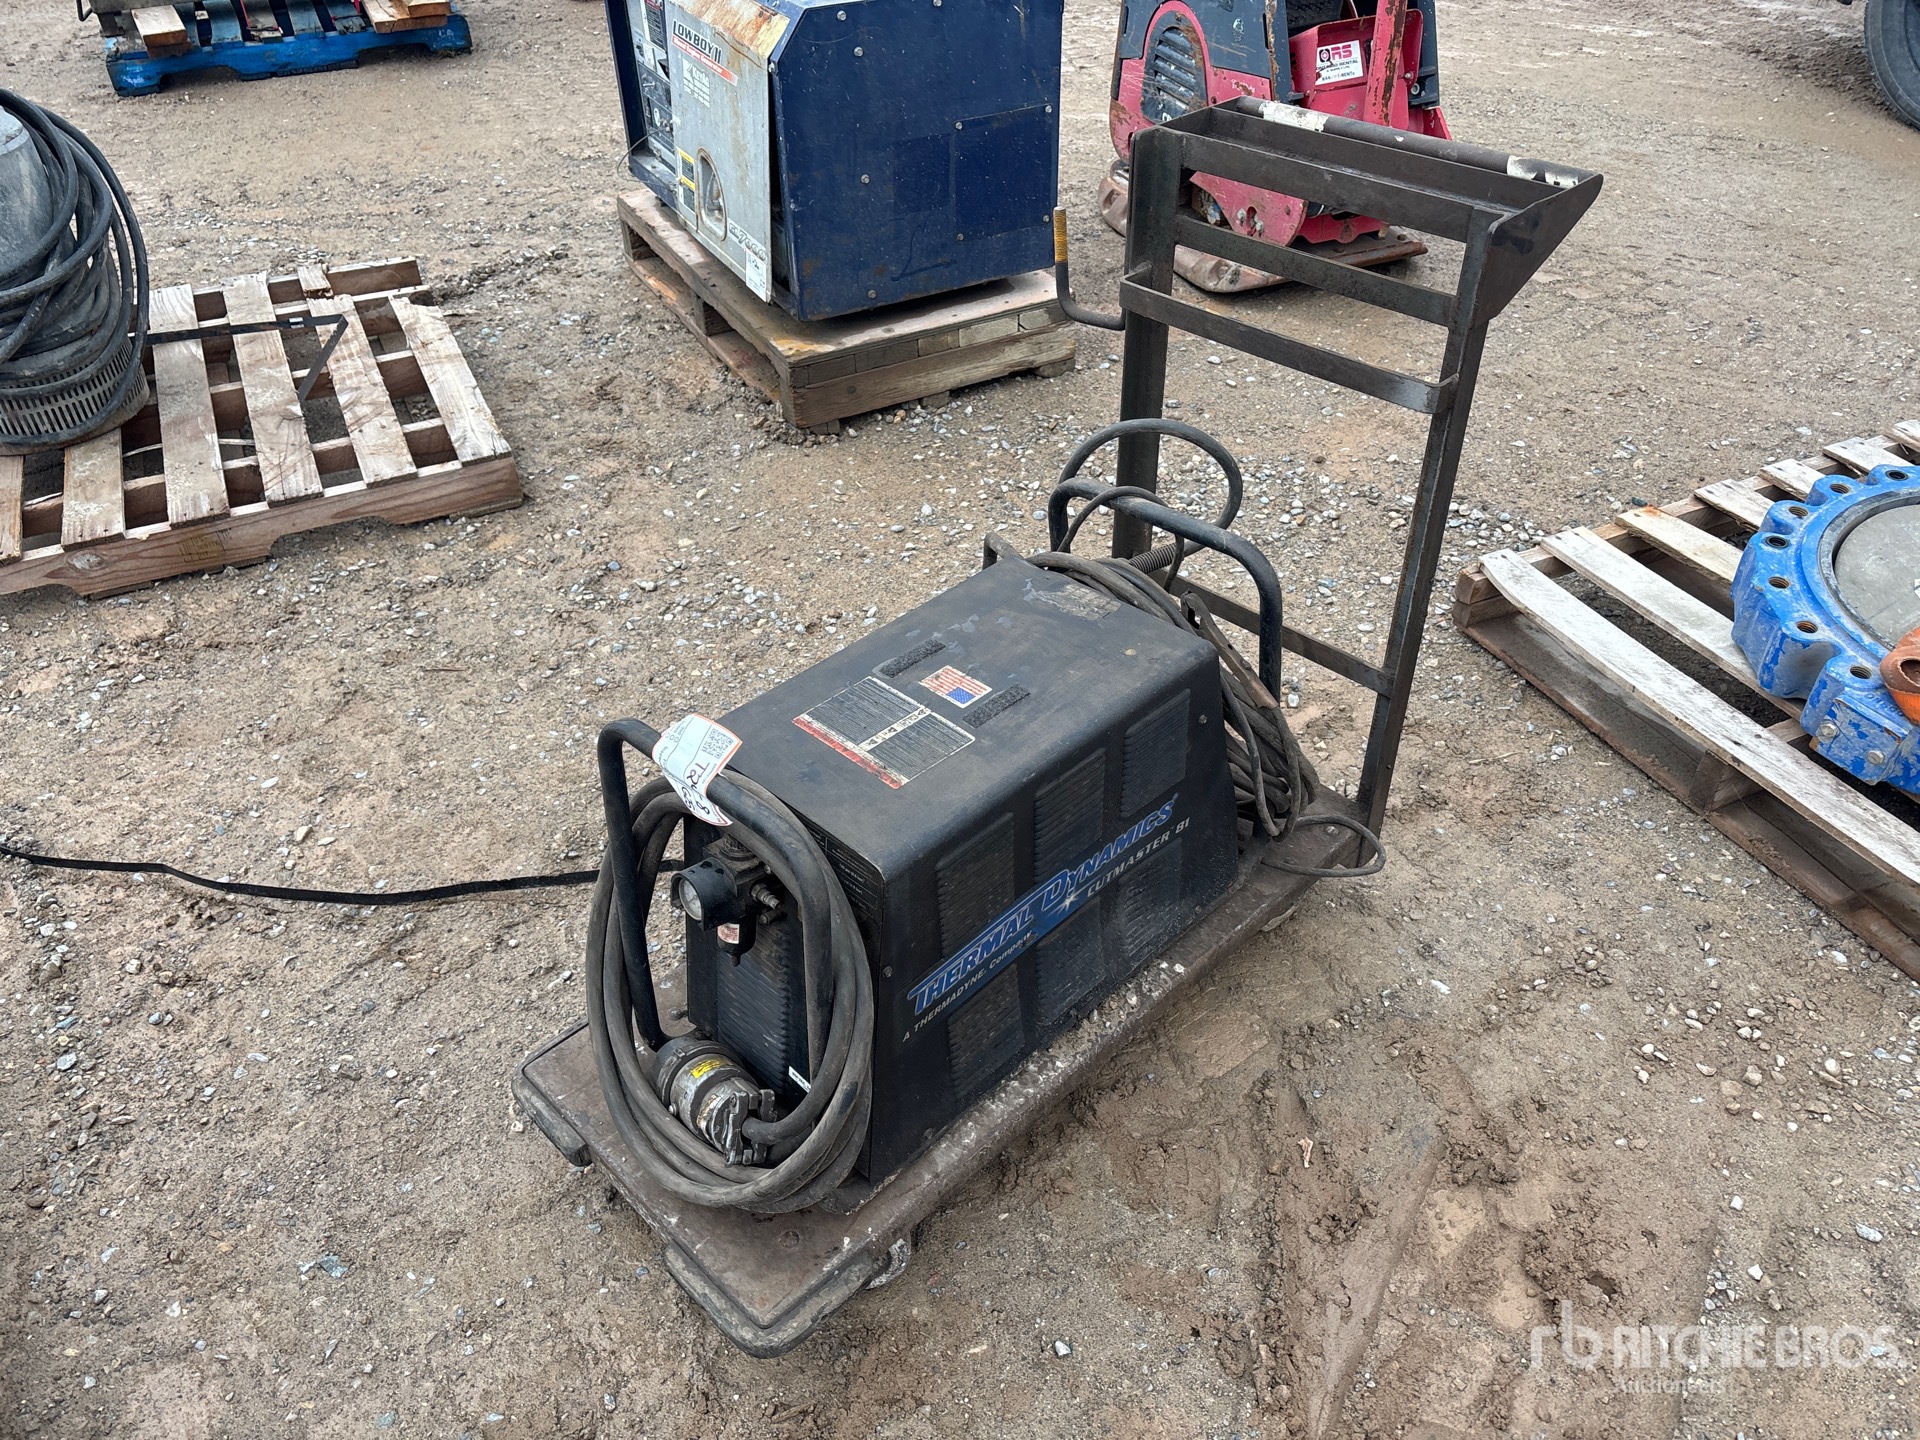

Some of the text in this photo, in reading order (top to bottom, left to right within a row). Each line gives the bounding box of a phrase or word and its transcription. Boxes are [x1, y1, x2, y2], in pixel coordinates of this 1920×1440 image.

[673, 20, 714, 57] LOWBOY
[1087, 817, 1190, 897] CUTMASTER 81
[908, 801, 1174, 1016] THERMAL DYNAMICS
[903, 1031, 910, 1042] A
[989, 930, 1034, 969] Company
